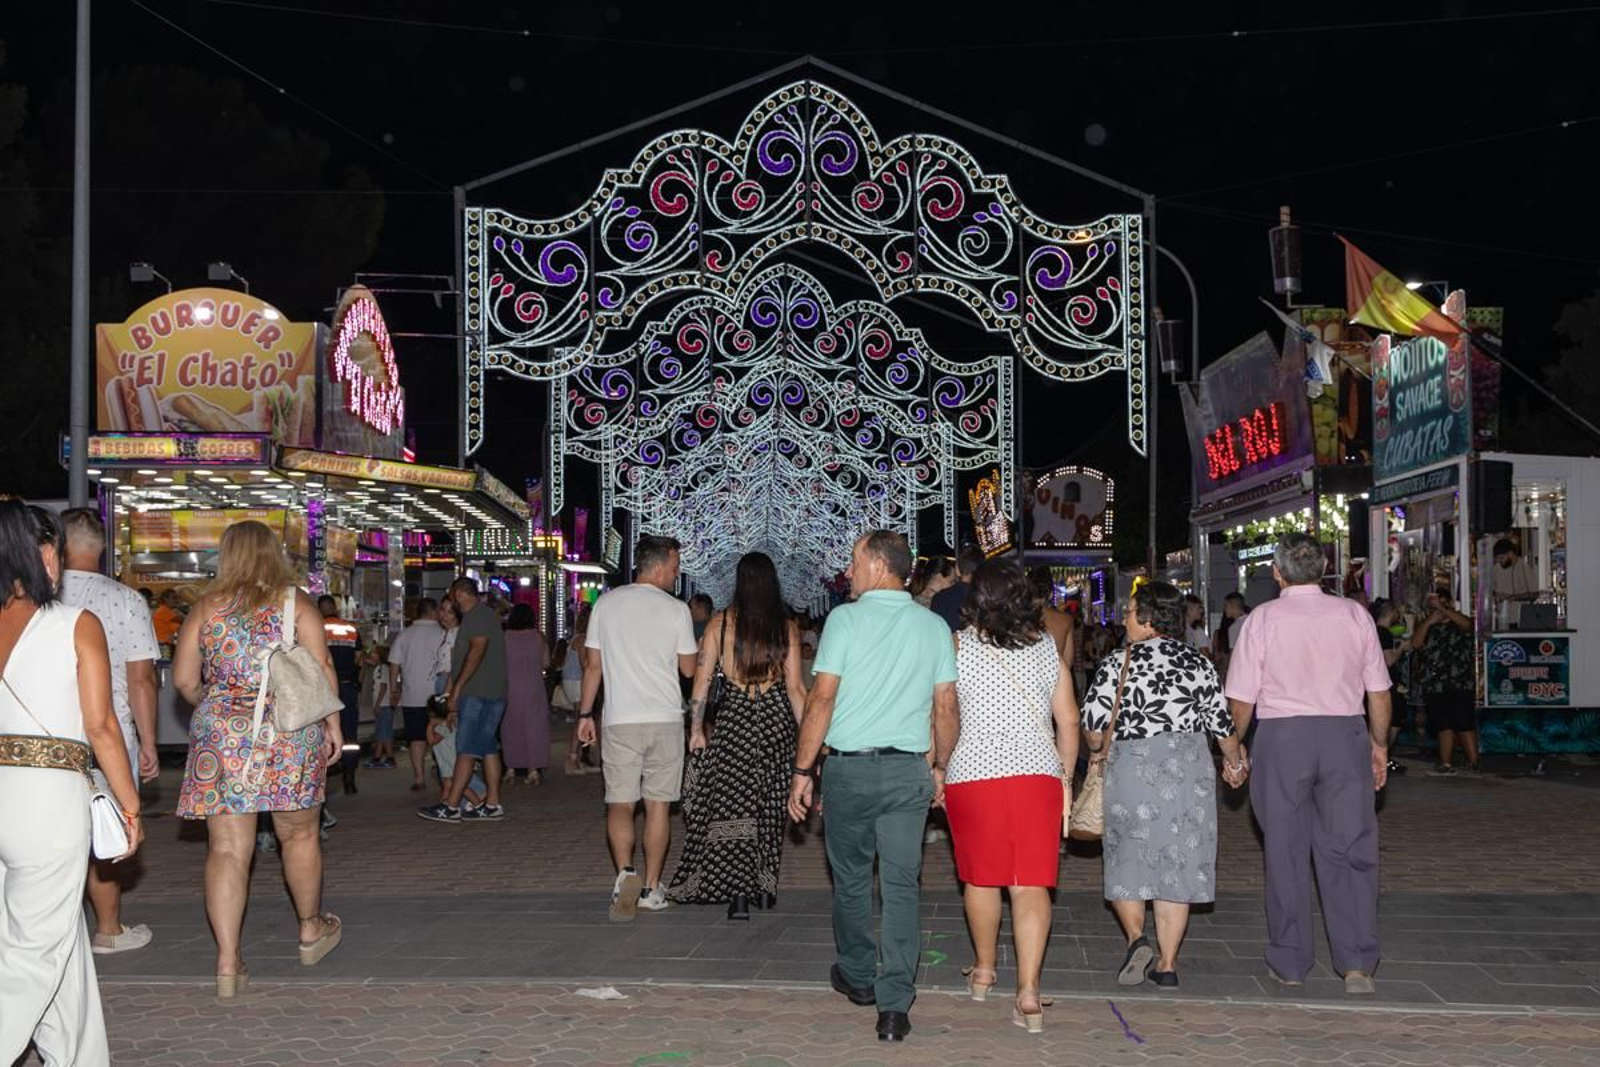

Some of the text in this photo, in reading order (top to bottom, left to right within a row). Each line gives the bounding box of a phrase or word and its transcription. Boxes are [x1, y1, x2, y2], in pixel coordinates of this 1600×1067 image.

[130, 300, 283, 351] BURGUER
[1390, 335, 1448, 386] MOJITOS
[1395, 375, 1443, 421] SAVAGE
[104, 441, 166, 456] BEBIDAS
[1383, 415, 1453, 471] CUBATAS
[1529, 683, 1565, 696] DYC
